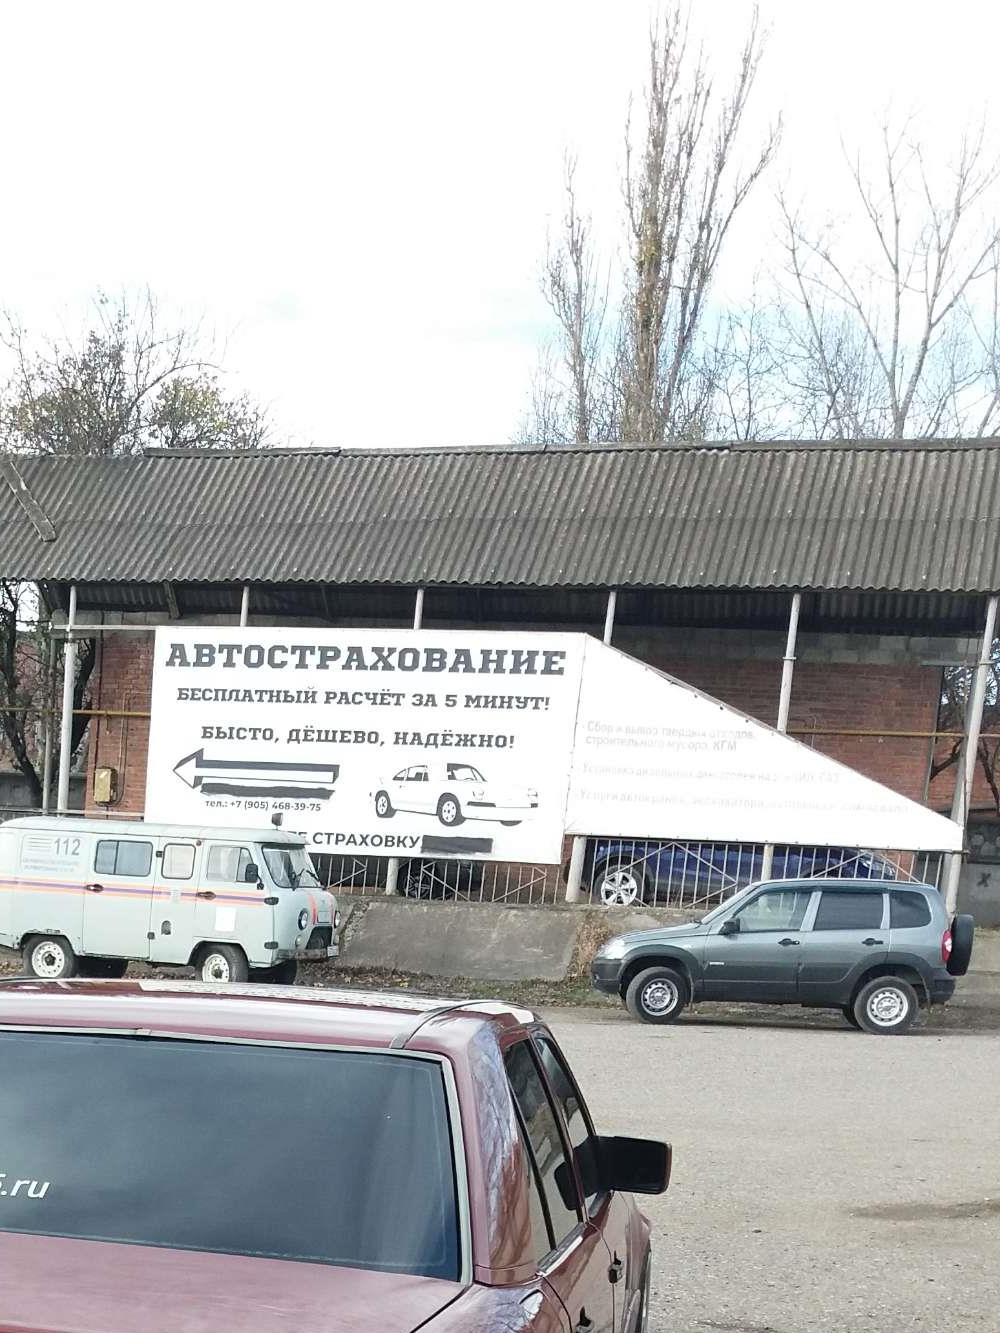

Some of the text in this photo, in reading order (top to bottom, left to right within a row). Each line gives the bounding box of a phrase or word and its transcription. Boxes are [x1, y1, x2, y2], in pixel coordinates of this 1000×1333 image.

[165, 643, 566, 676] АВТОСТРАХОВАНИЕ
[177, 686, 551, 711] БЕСПЛАТНЫЙ РАСЧЁТ ЗА 5 МИНУТ!
[201, 725, 515, 749] БЫСТО, ДЁШЕВО, НАДЁЖНО!
[230, 800, 242, 808] +7
[244, 800, 269, 811] (905)
[272, 801, 321, 812] 468-39-75
[54, 838, 81, 856] 112
[312, 831, 420, 849] СТРАХОВКУ
